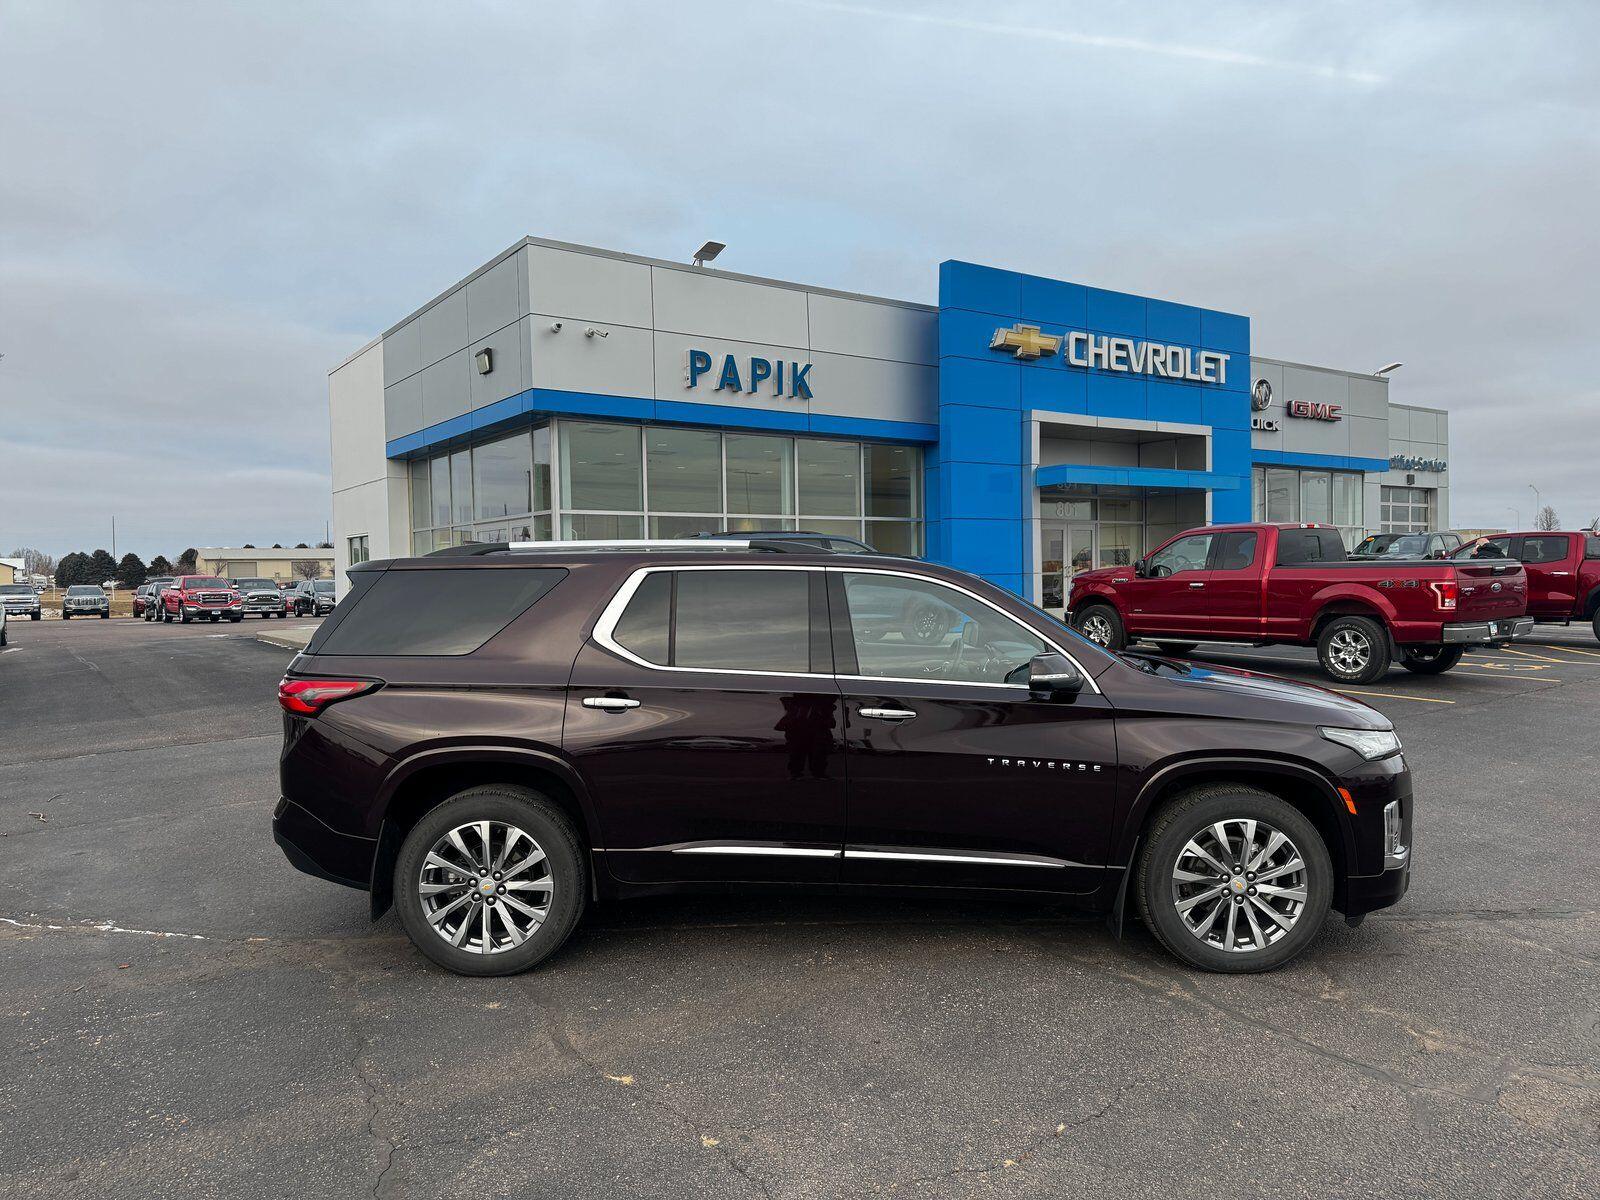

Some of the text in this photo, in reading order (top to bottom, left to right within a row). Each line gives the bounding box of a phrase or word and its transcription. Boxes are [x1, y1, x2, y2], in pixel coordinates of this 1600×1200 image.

[1065, 331, 1231, 384] CHEVROLET
[685, 349, 814, 399] PAPIK
[1287, 400, 1342, 422] GMC
[1251, 418, 1280, 431] UICK
[987, 758, 1101, 772] TRAVERSE
